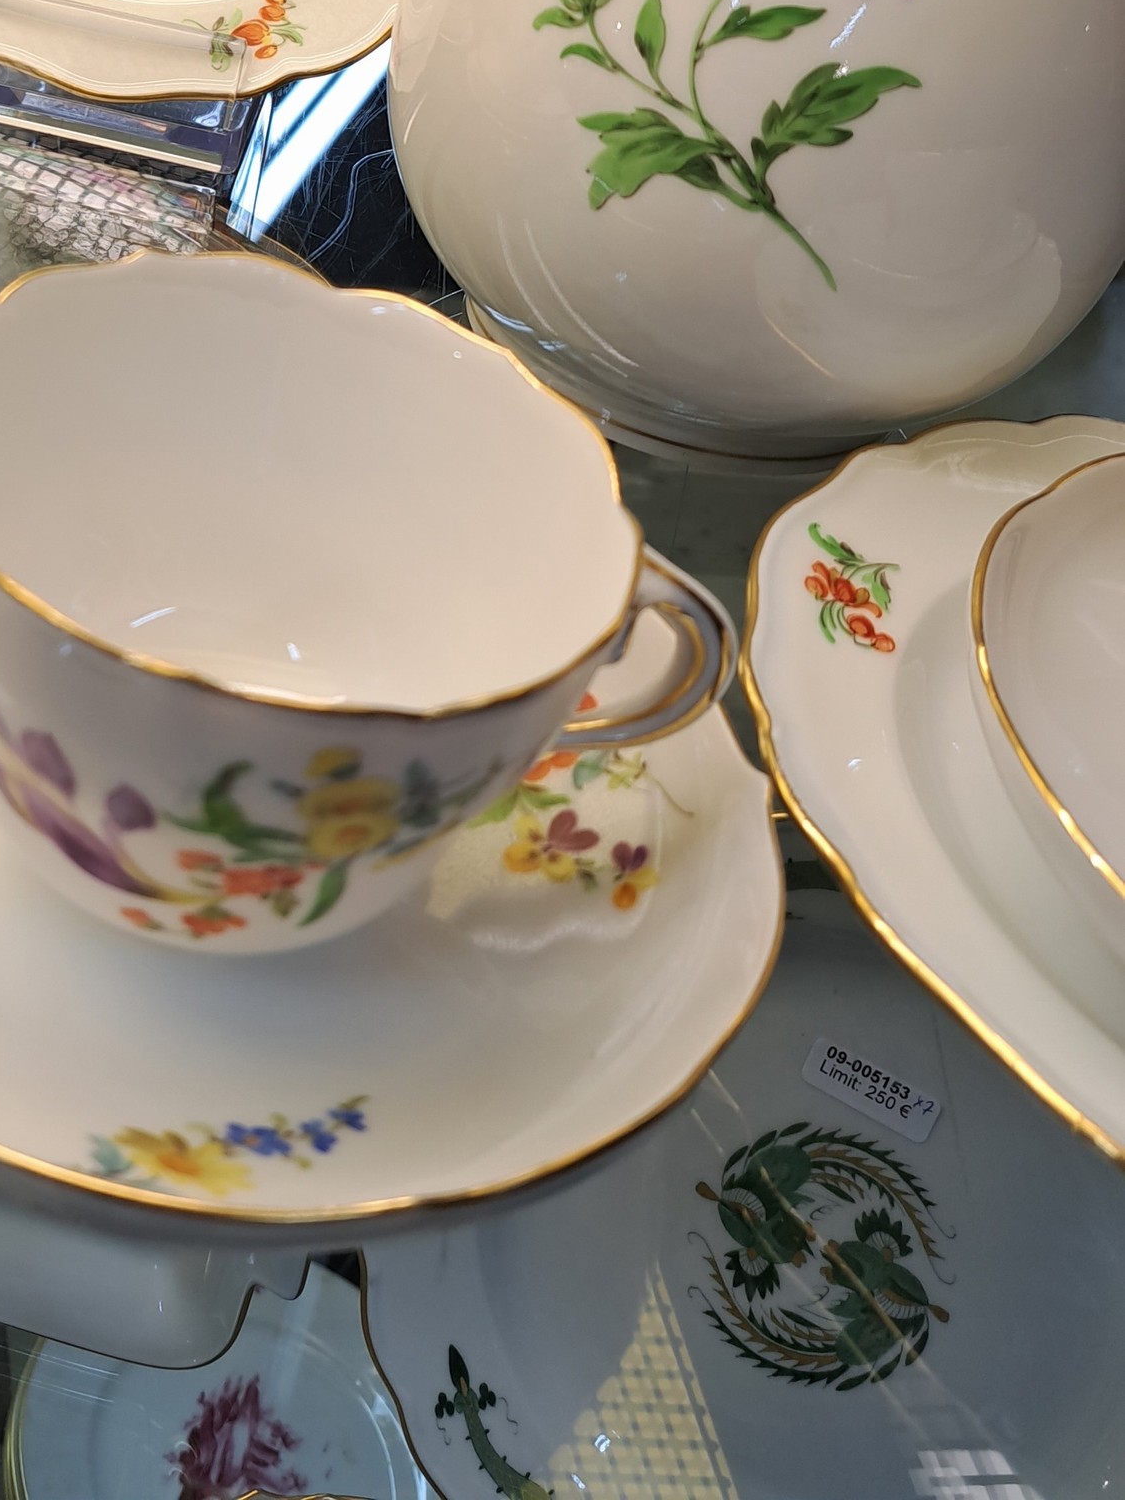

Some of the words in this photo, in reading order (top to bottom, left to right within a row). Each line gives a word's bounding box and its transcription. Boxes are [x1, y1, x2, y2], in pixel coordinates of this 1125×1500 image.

[819, 1059, 862, 1092] Limit:
[864, 1085, 896, 1110] 250
[899, 1104, 913, 1119] €
[826, 1046, 911, 1100] 09-005153
